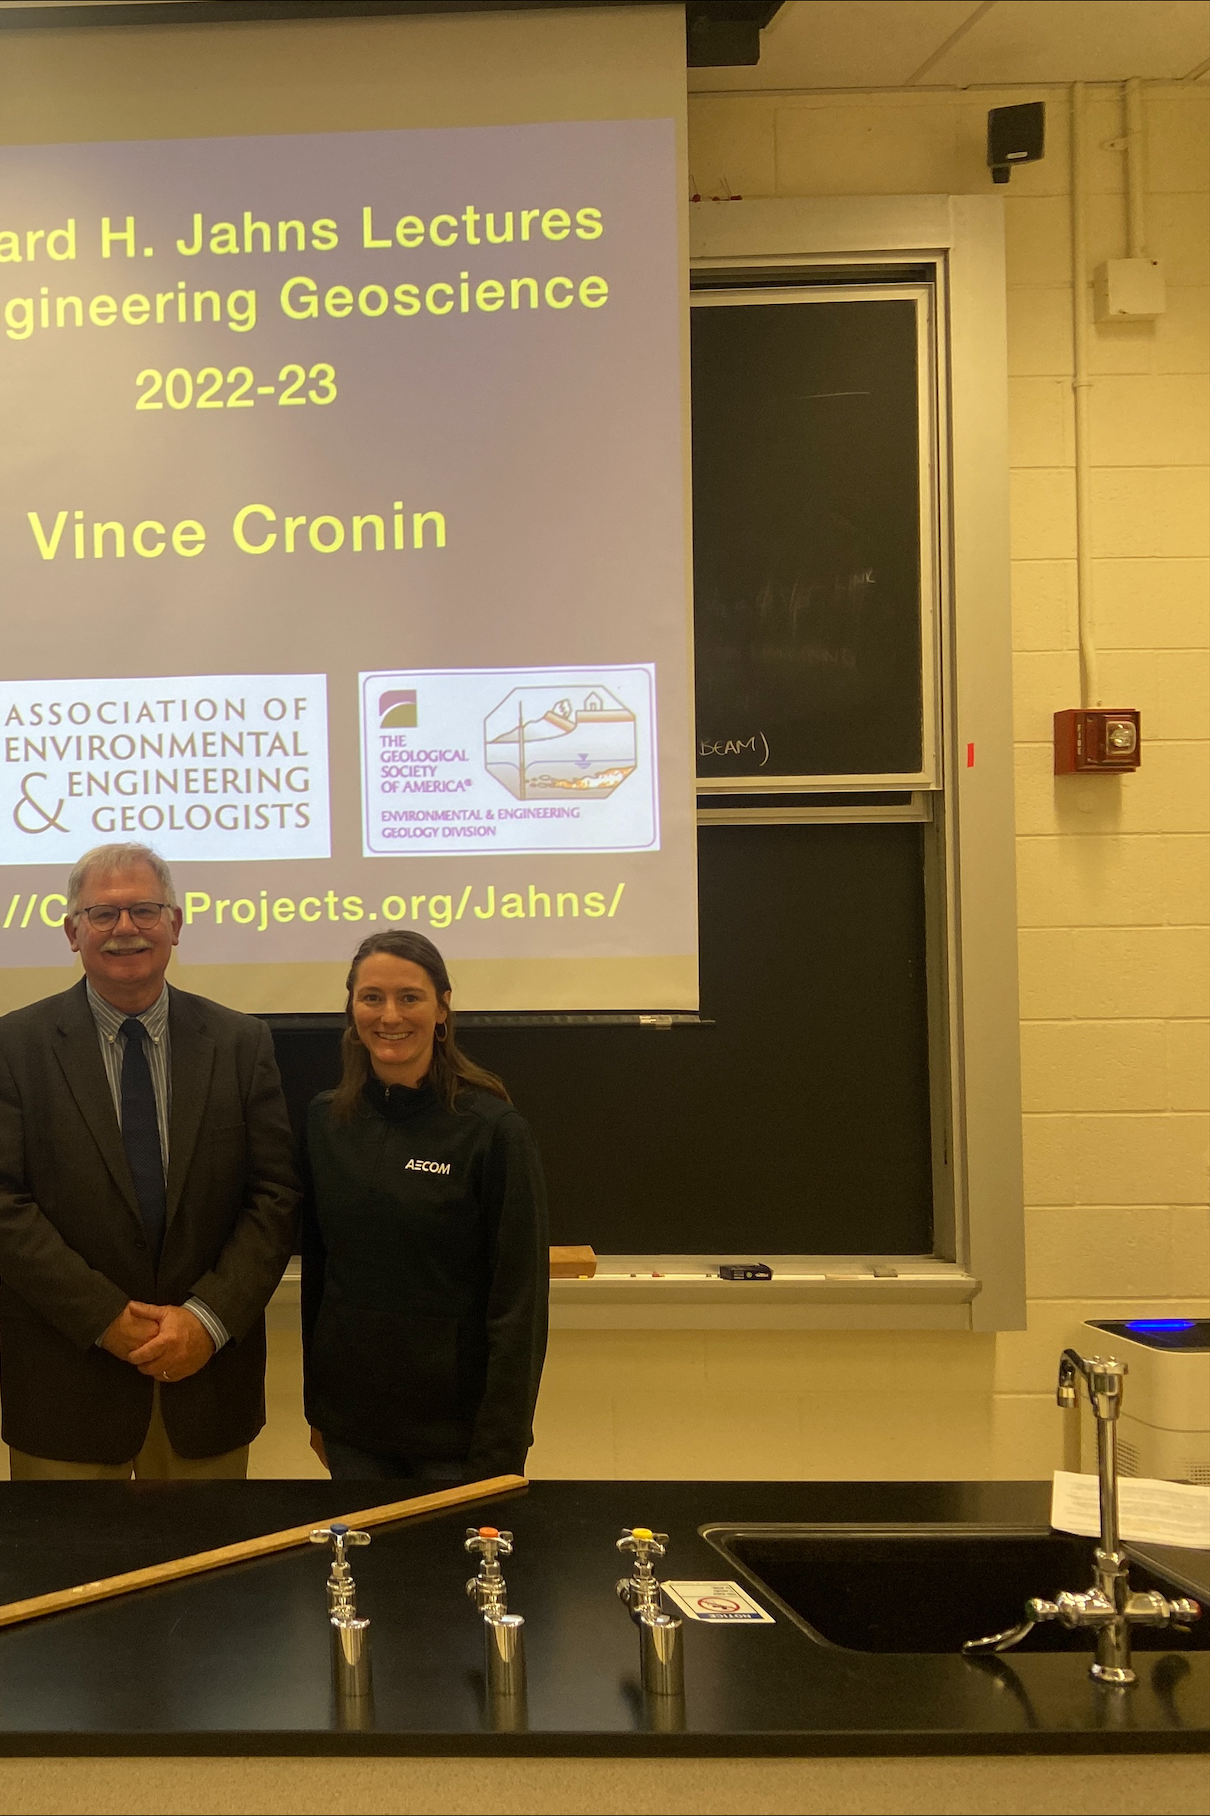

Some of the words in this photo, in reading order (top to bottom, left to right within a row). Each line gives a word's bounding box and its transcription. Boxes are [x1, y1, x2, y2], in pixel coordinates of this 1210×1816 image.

[101, 217, 154, 259] H.
[176, 211, 338, 259] Jahns
[362, 204, 604, 251] Lectures
[280, 269, 609, 321] Geoscience
[135, 363, 337, 411] 2022-23
[27, 508, 207, 562] Vince
[232, 501, 447, 556] Cronin
[4, 698, 245, 727] ASSOCIATION
[263, 697, 307, 721] OF
[5, 731, 309, 763] ENVIRONMENTAL
[378, 735, 407, 748] THE
[380, 749, 470, 763] GEOLOGICAL
[380, 765, 437, 778] SOCIETY
[381, 780, 400, 793] OF
[12, 771, 71, 834] &
[68, 766, 310, 797] ENGINEERING
[381, 809, 483, 822] ENVIRONMENTAL
[485, 809, 494, 820] &
[497, 806, 580, 820] ENGINEERING
[91, 803, 310, 833] GEOLOGISTS
[381, 826, 439, 839] GEOLOGY
[441, 825, 496, 838] DIVISION
[404, 1158, 451, 1175] AECOM
